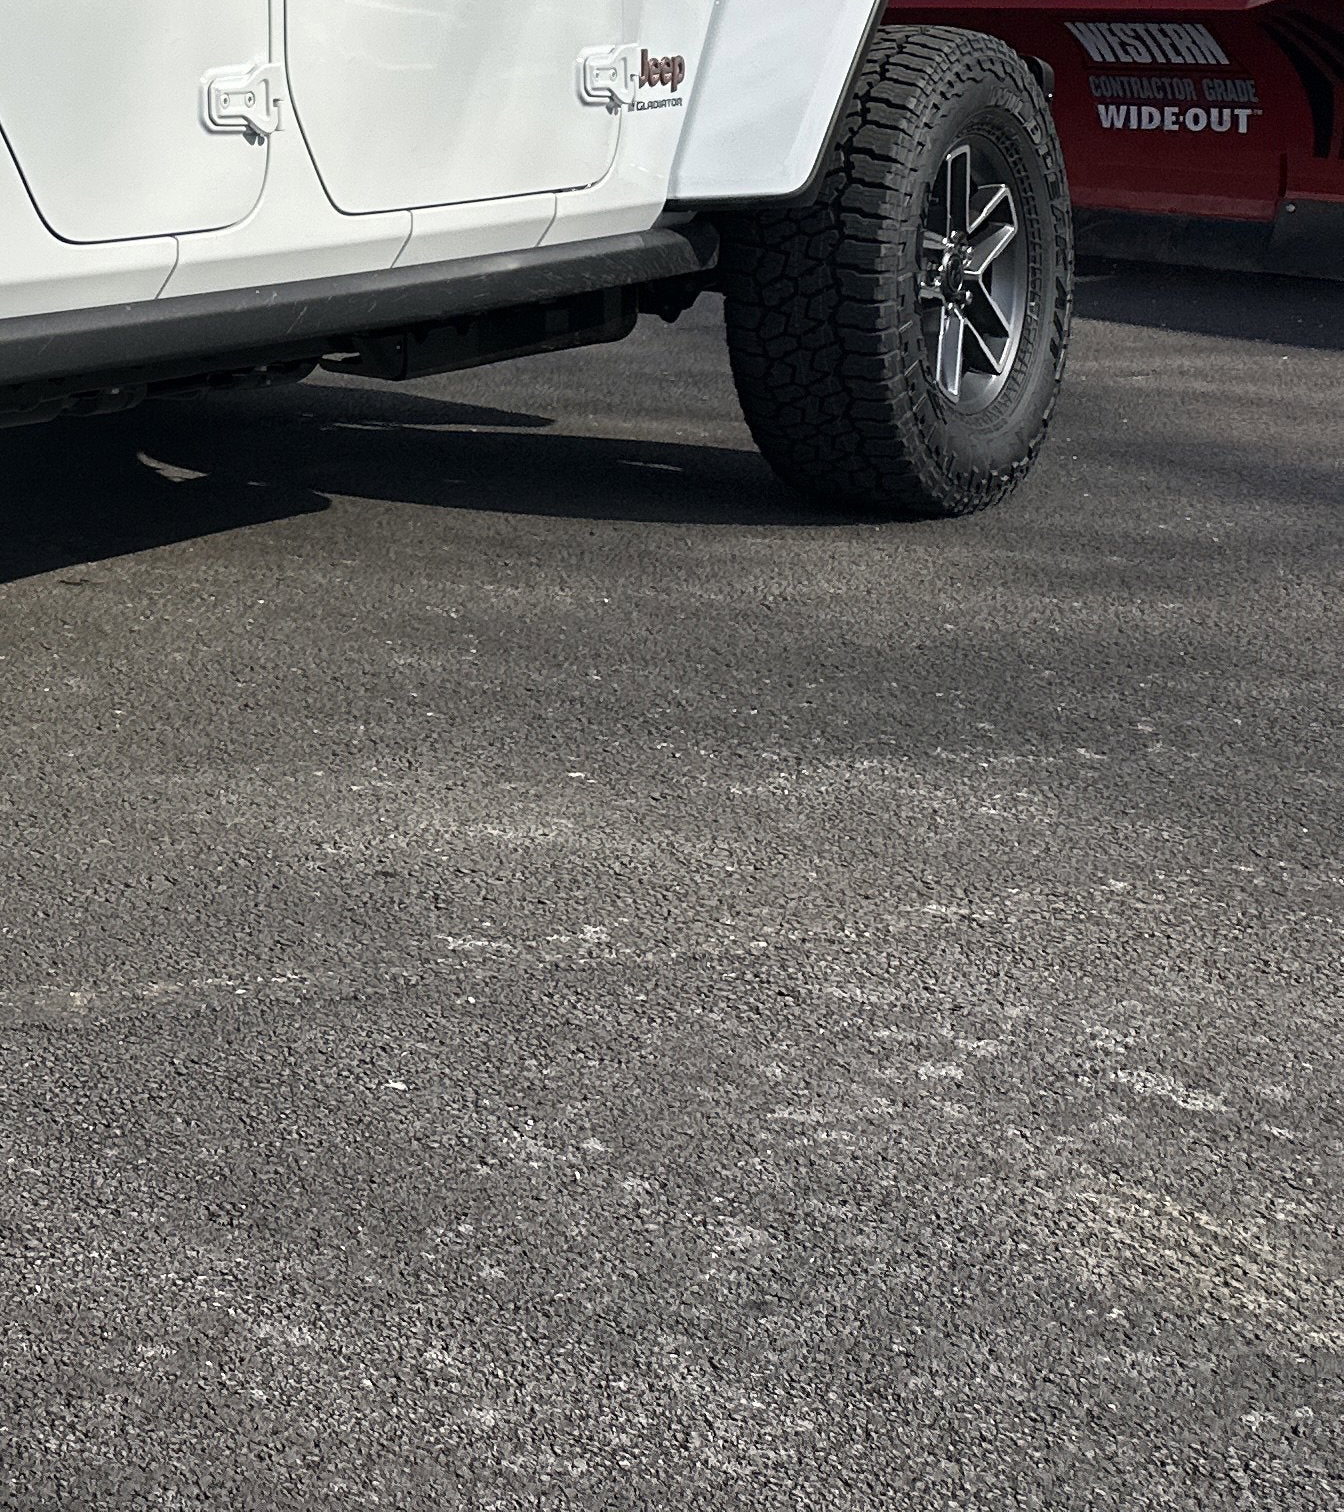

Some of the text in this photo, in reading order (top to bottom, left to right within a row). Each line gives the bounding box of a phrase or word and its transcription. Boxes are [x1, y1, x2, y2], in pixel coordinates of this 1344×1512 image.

[1063, 22, 1230, 65] WESTERN
[639, 48, 685, 93] Jeep
[636, 97, 683, 112] GLADIATOR
[1088, 75, 1259, 103] CONTRACTOR GRADE
